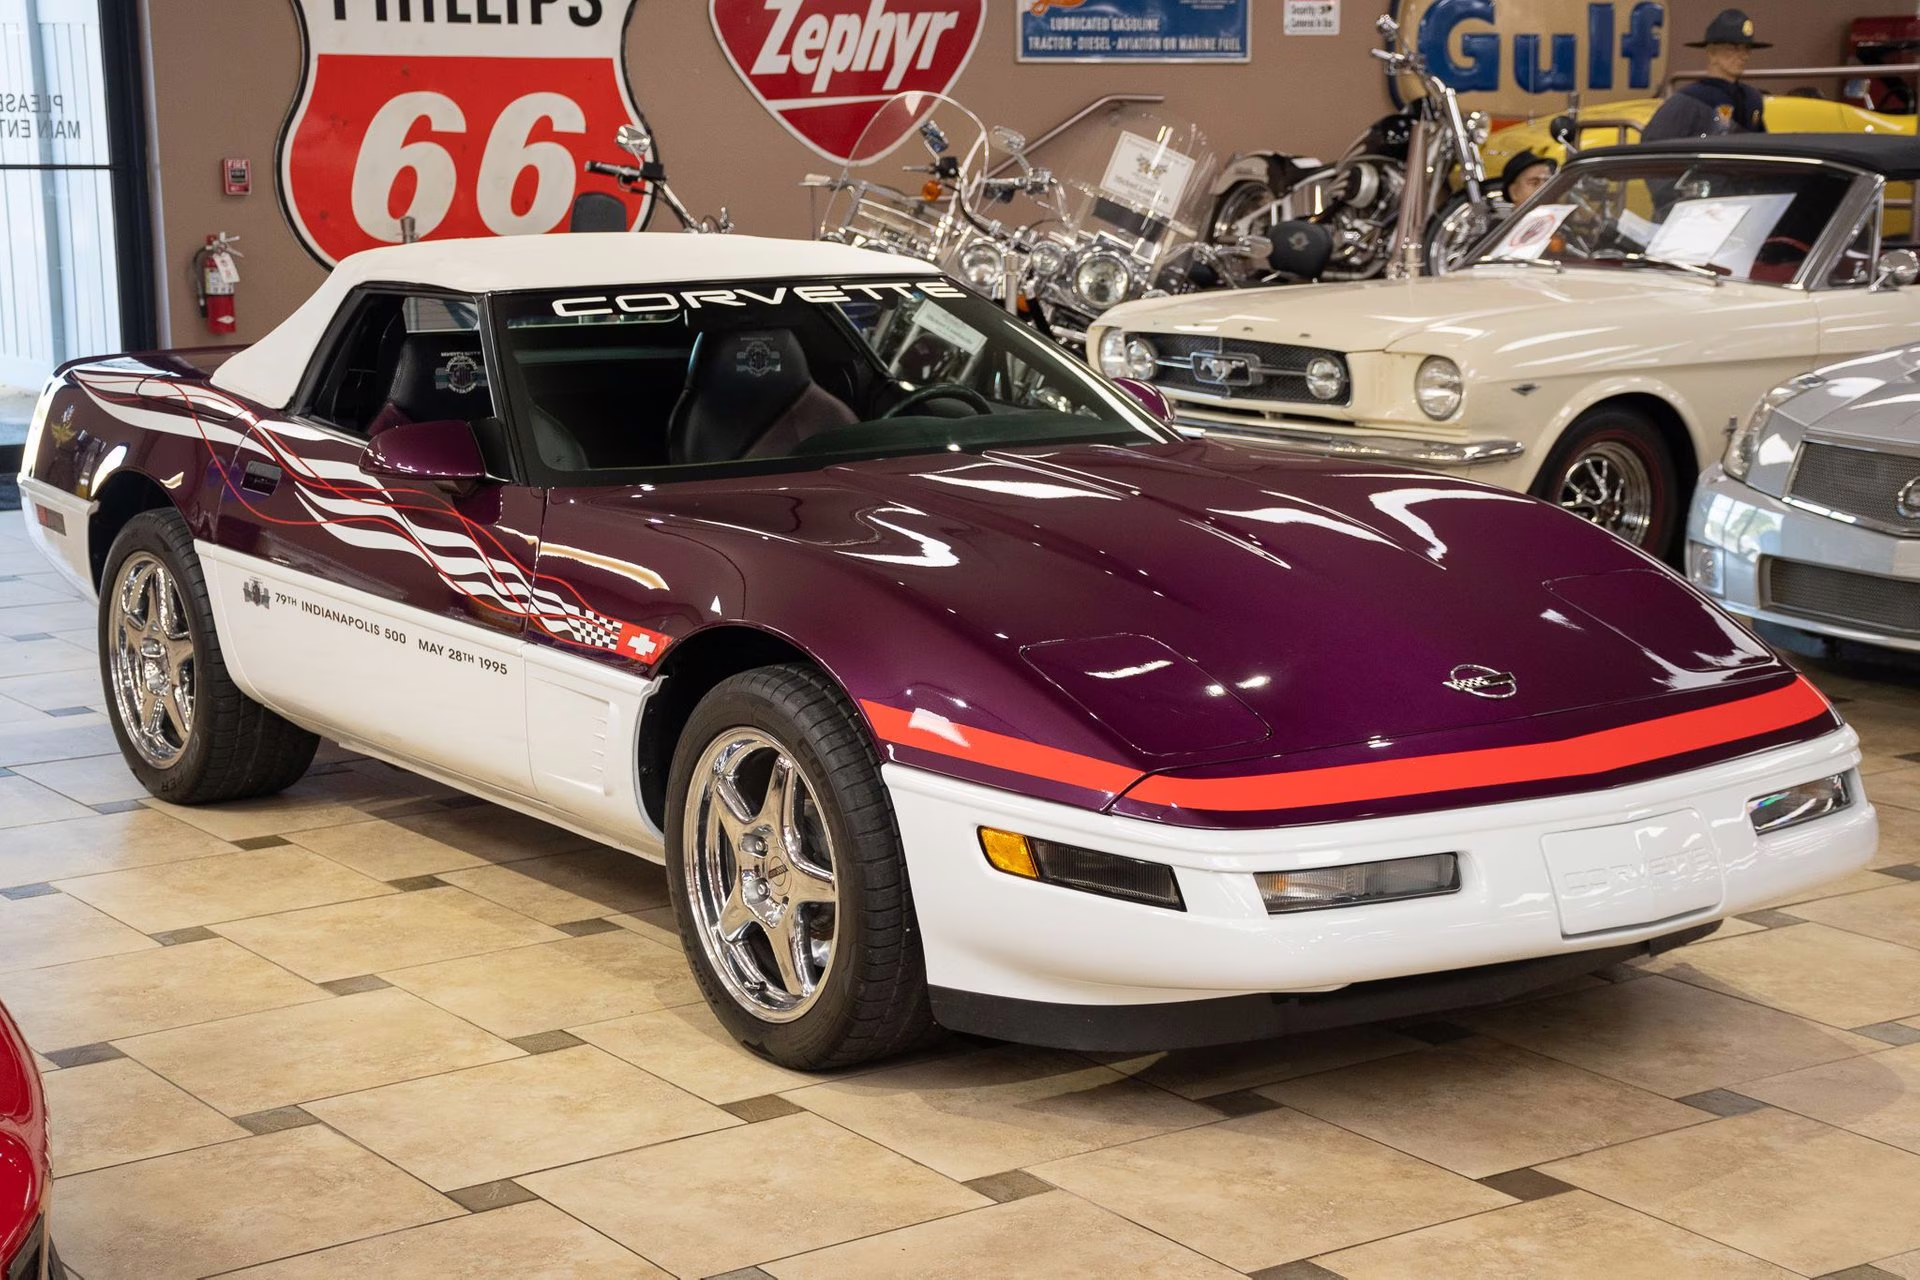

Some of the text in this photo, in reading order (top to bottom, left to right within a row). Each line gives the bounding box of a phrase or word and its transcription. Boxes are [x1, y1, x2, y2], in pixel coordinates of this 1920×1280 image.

[750, 0, 960, 93] Zephyr
[1417, 0, 1665, 93] Gulf
[351, 90, 587, 243] 66
[551, 281, 968, 318] CORVETTE
[274, 592, 508, 676] 79TH INDIANAPOLIS 500 MAY 28TH 1995
[1563, 846, 1715, 890] CORETTE
